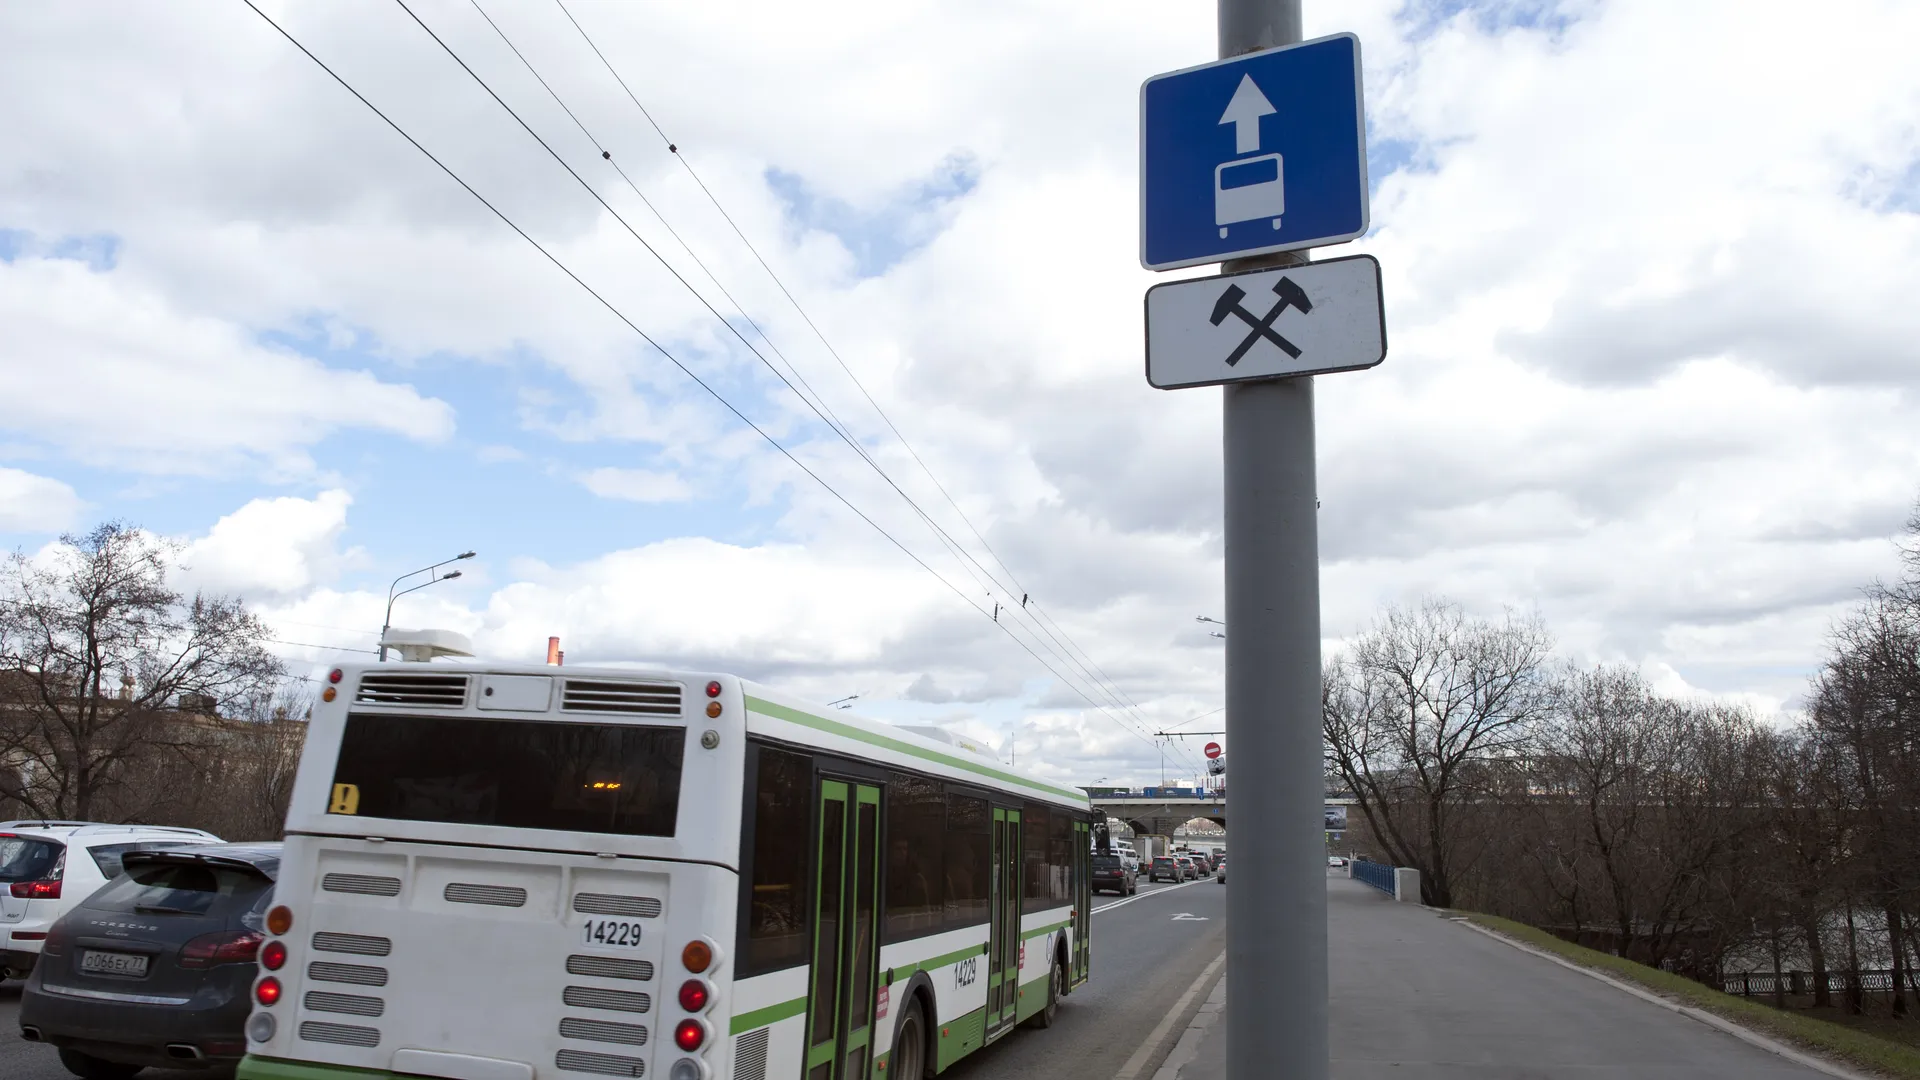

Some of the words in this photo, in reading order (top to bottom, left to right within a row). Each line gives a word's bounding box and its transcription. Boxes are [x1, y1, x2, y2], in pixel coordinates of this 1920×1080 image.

[91, 920, 158, 931] PORSCHE
[584, 920, 642, 947] 14229
[954, 957, 976, 990] 14229
